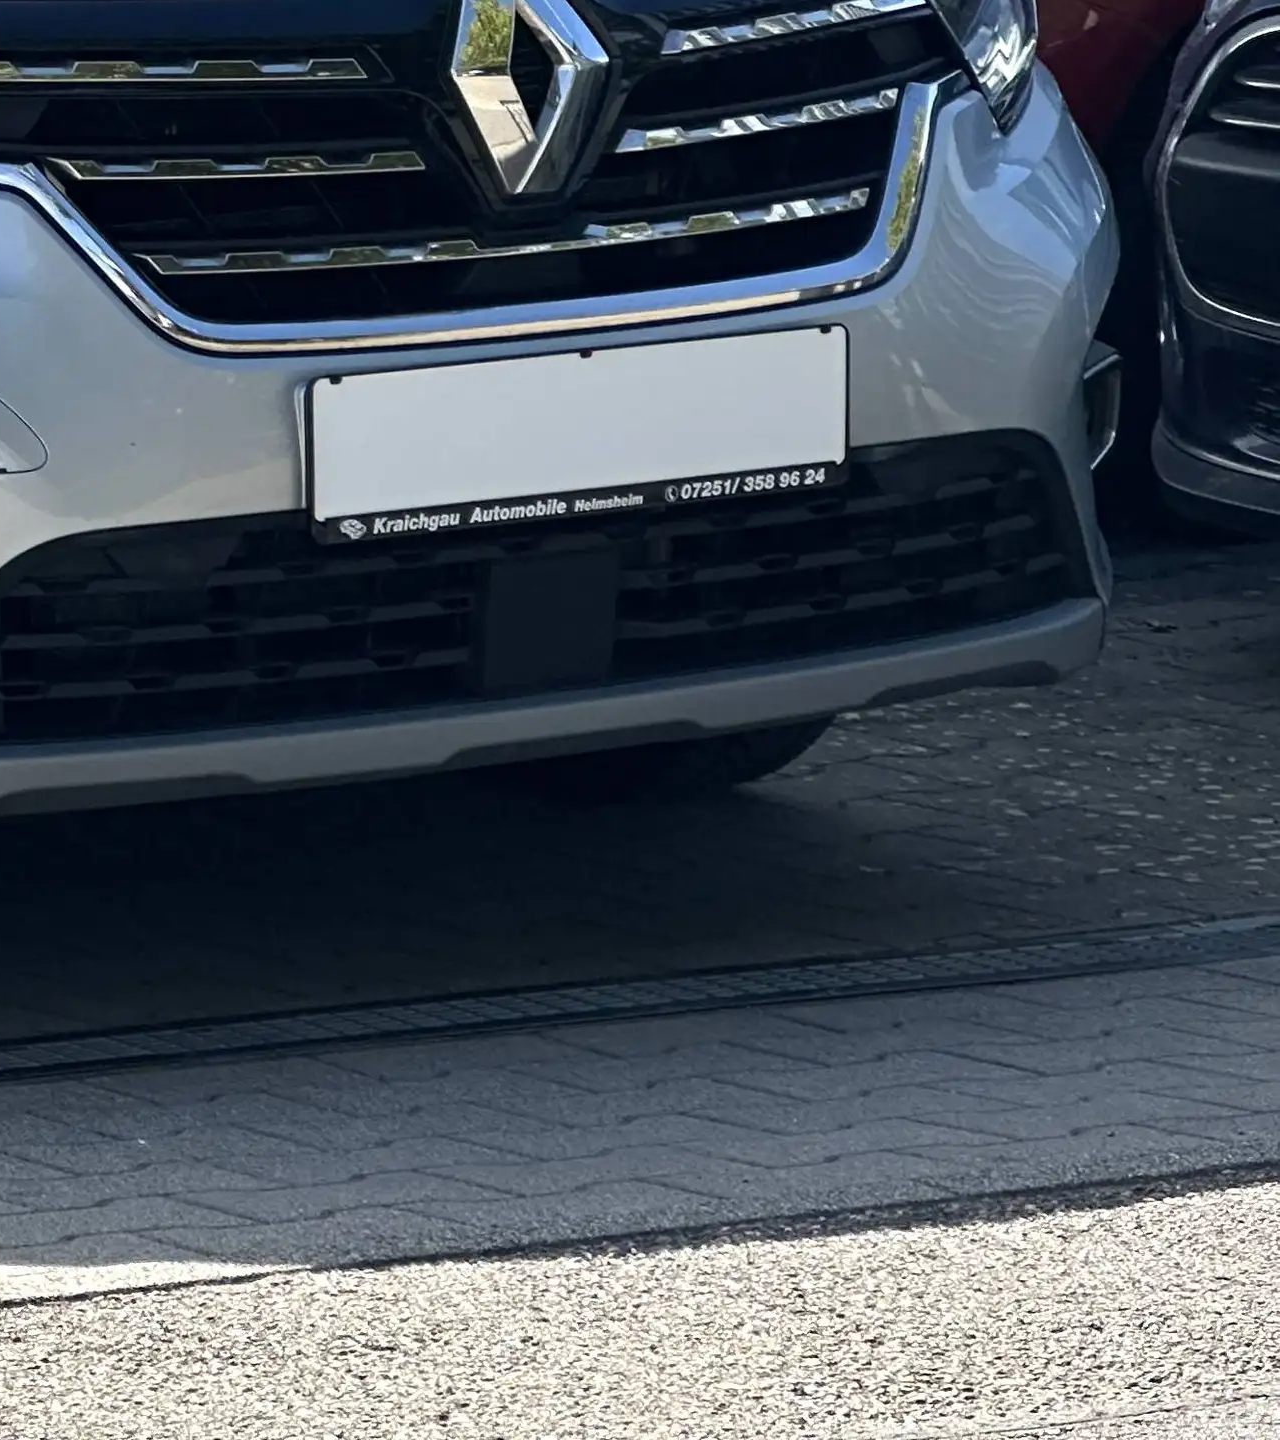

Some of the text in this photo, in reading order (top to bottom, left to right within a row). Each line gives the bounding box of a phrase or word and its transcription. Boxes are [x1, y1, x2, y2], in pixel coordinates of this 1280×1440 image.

[372, 467, 827, 535] Kraichgau Automobile Helmsheim 07251/ 358 96 24
